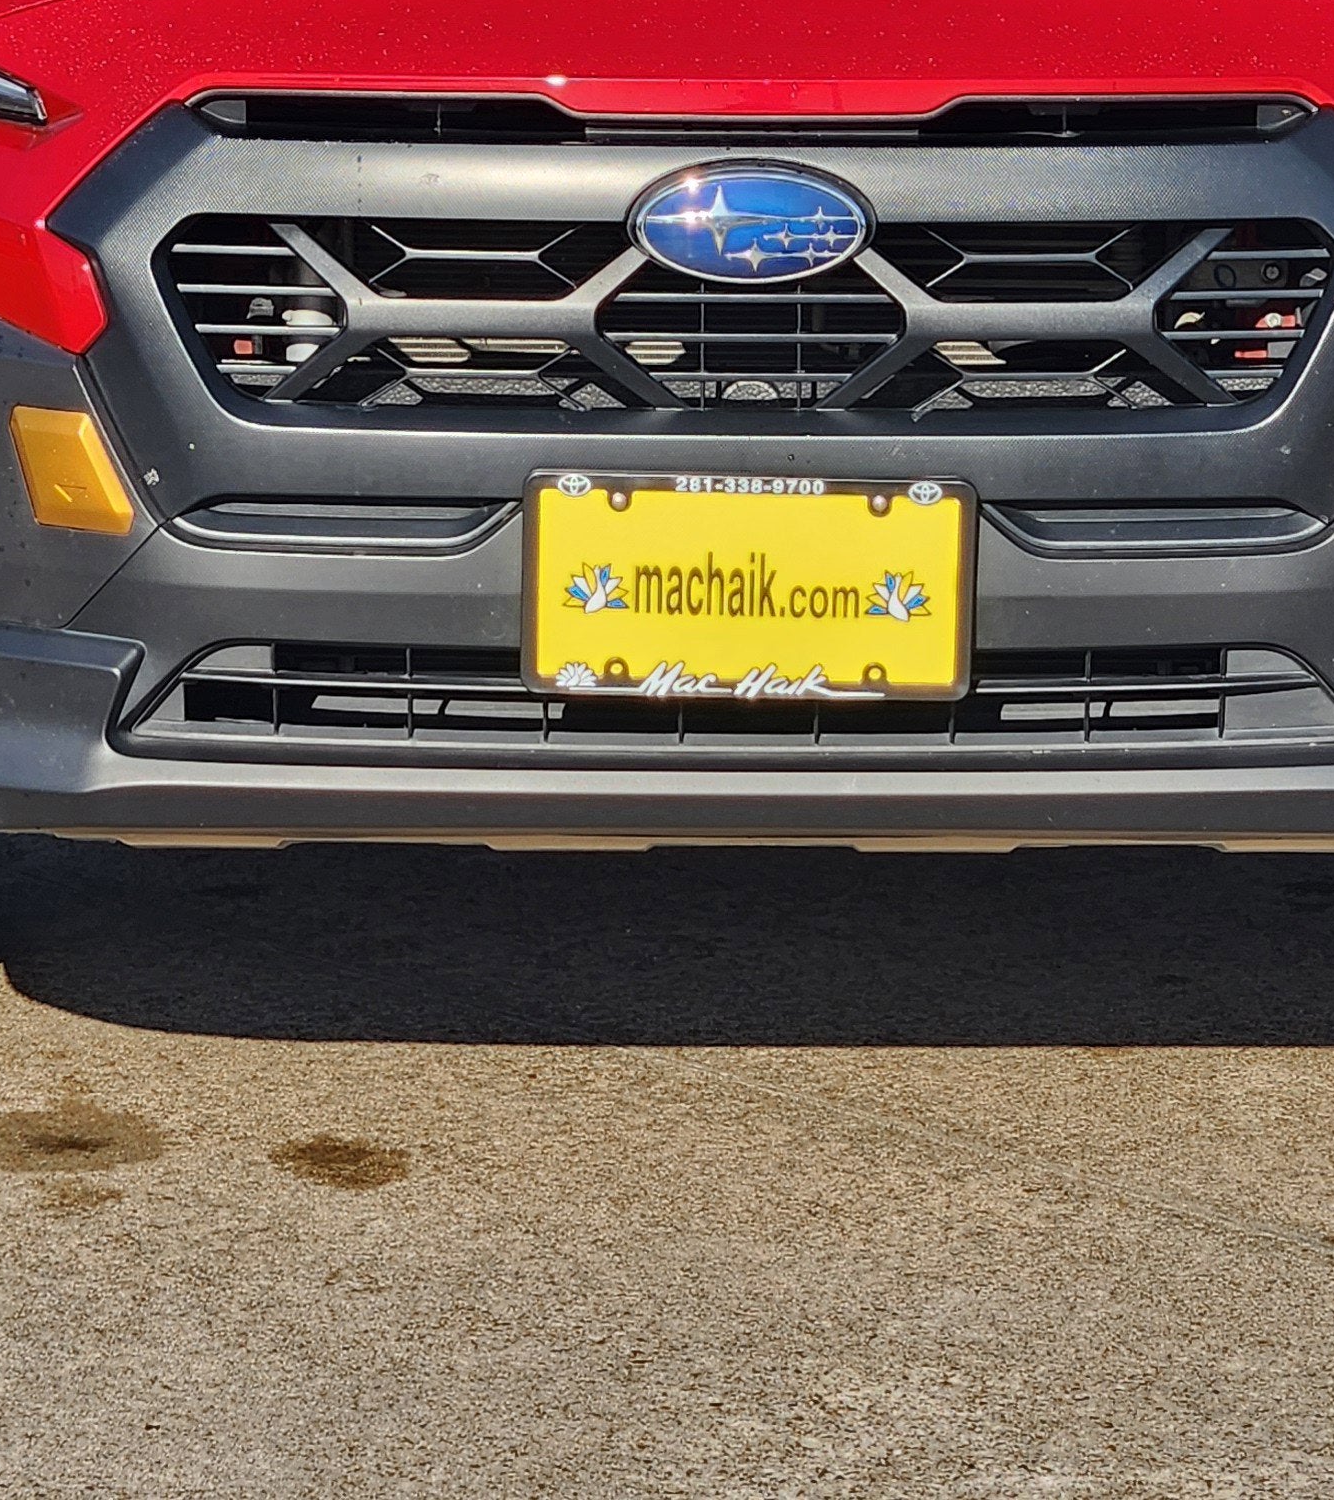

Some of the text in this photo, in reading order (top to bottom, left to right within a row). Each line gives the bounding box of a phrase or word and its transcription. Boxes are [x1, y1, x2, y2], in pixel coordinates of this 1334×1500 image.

[675, 476, 826, 496] 281-338-9700
[633, 552, 861, 619] machaik.com
[638, 661, 829, 697] Mac Haik
